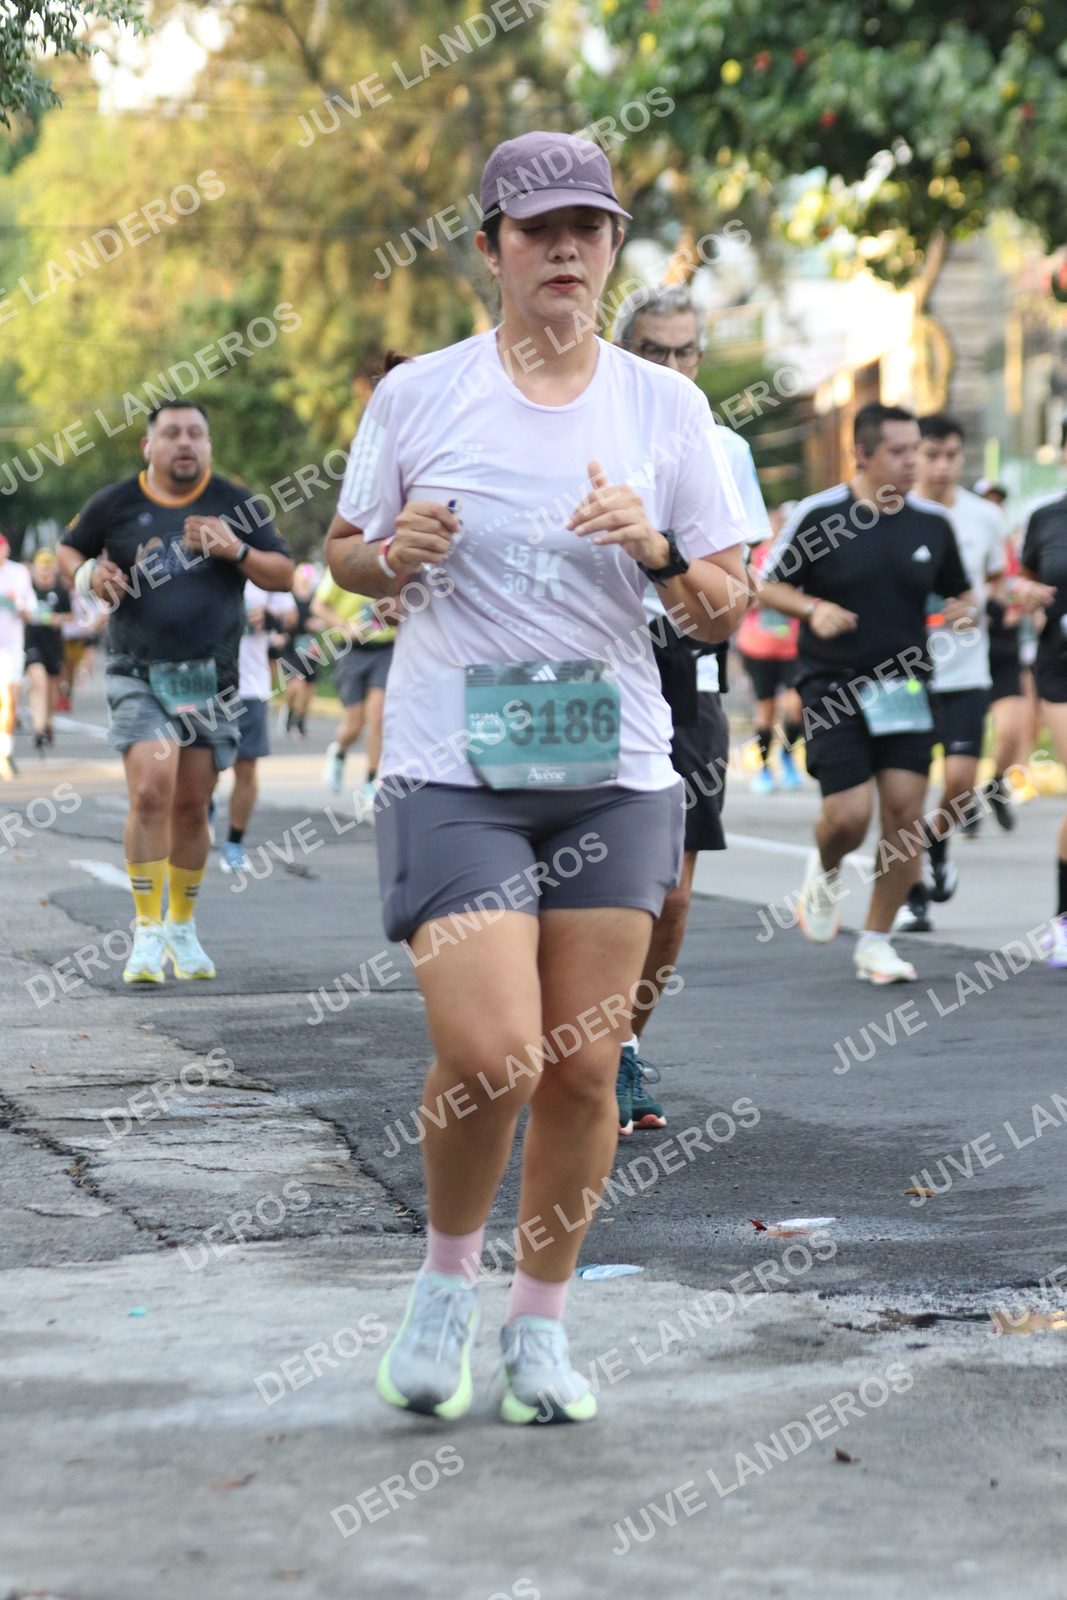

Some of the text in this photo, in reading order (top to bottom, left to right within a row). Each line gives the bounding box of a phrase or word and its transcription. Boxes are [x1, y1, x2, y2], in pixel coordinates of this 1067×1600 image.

[504, 544, 531, 567] 15
[502, 573, 529, 595] 30
[532, 547, 566, 601] K
